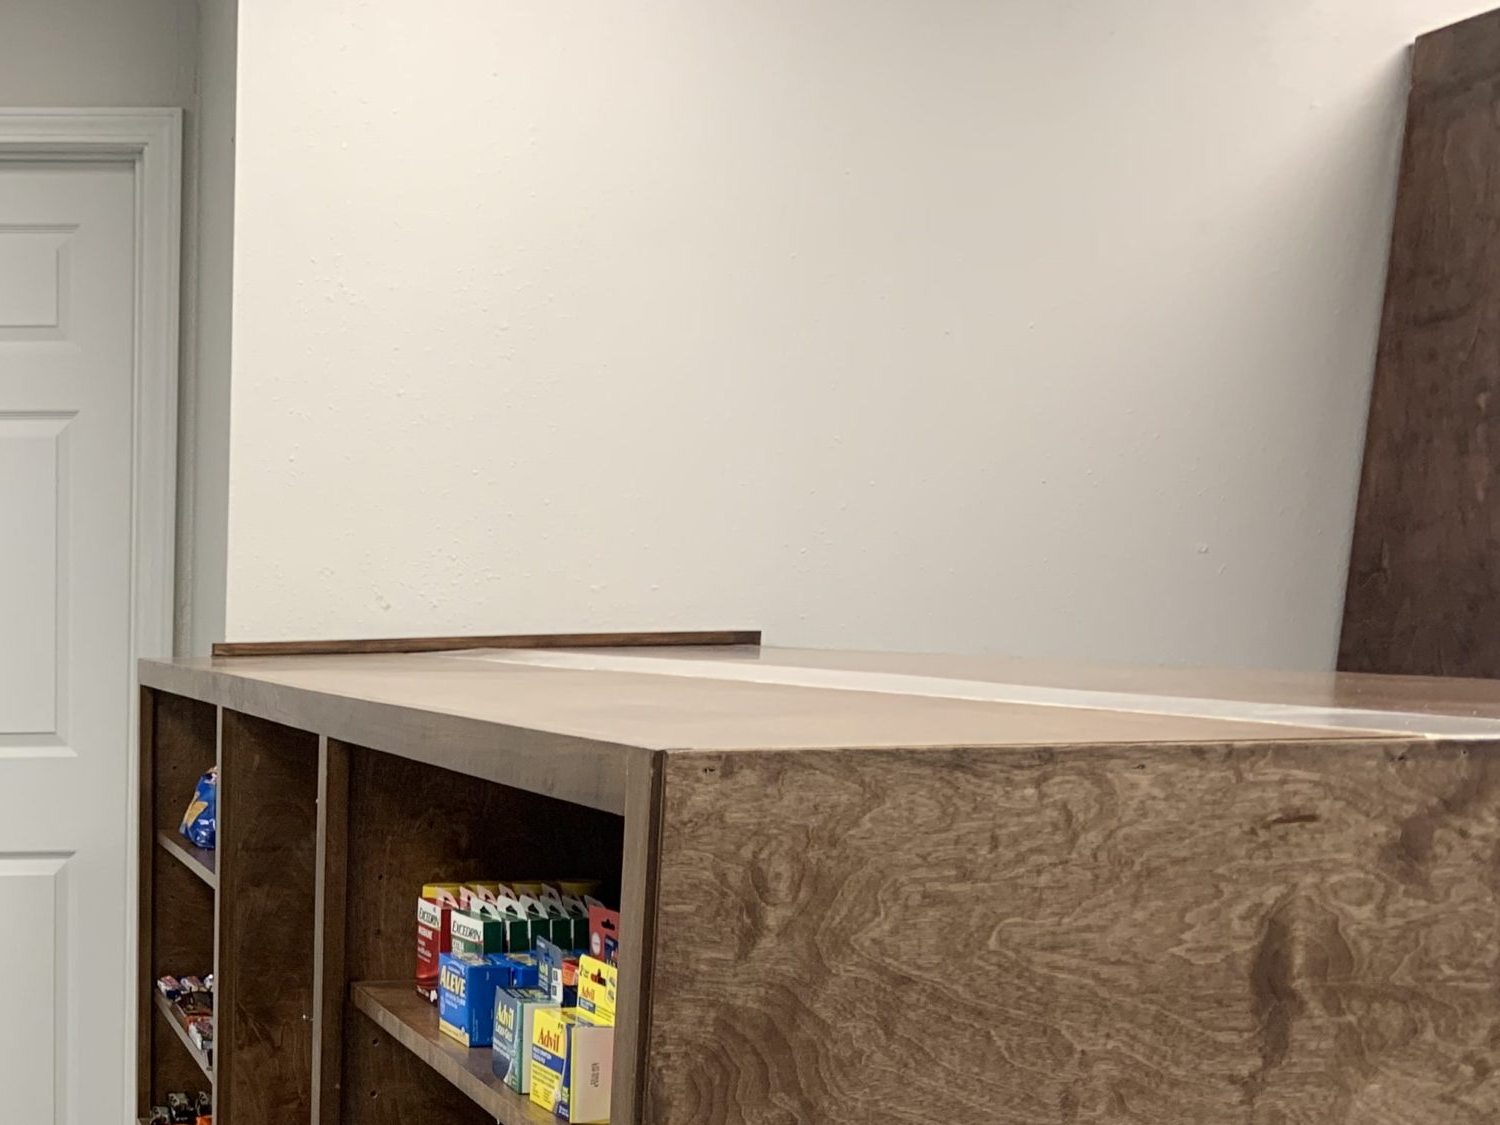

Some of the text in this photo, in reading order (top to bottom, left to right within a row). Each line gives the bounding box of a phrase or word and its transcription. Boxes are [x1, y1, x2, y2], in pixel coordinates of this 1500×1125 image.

[440, 964, 466, 997] ALEVE
[496, 1000, 515, 1030] Advil
[538, 1027, 561, 1053] Advil
